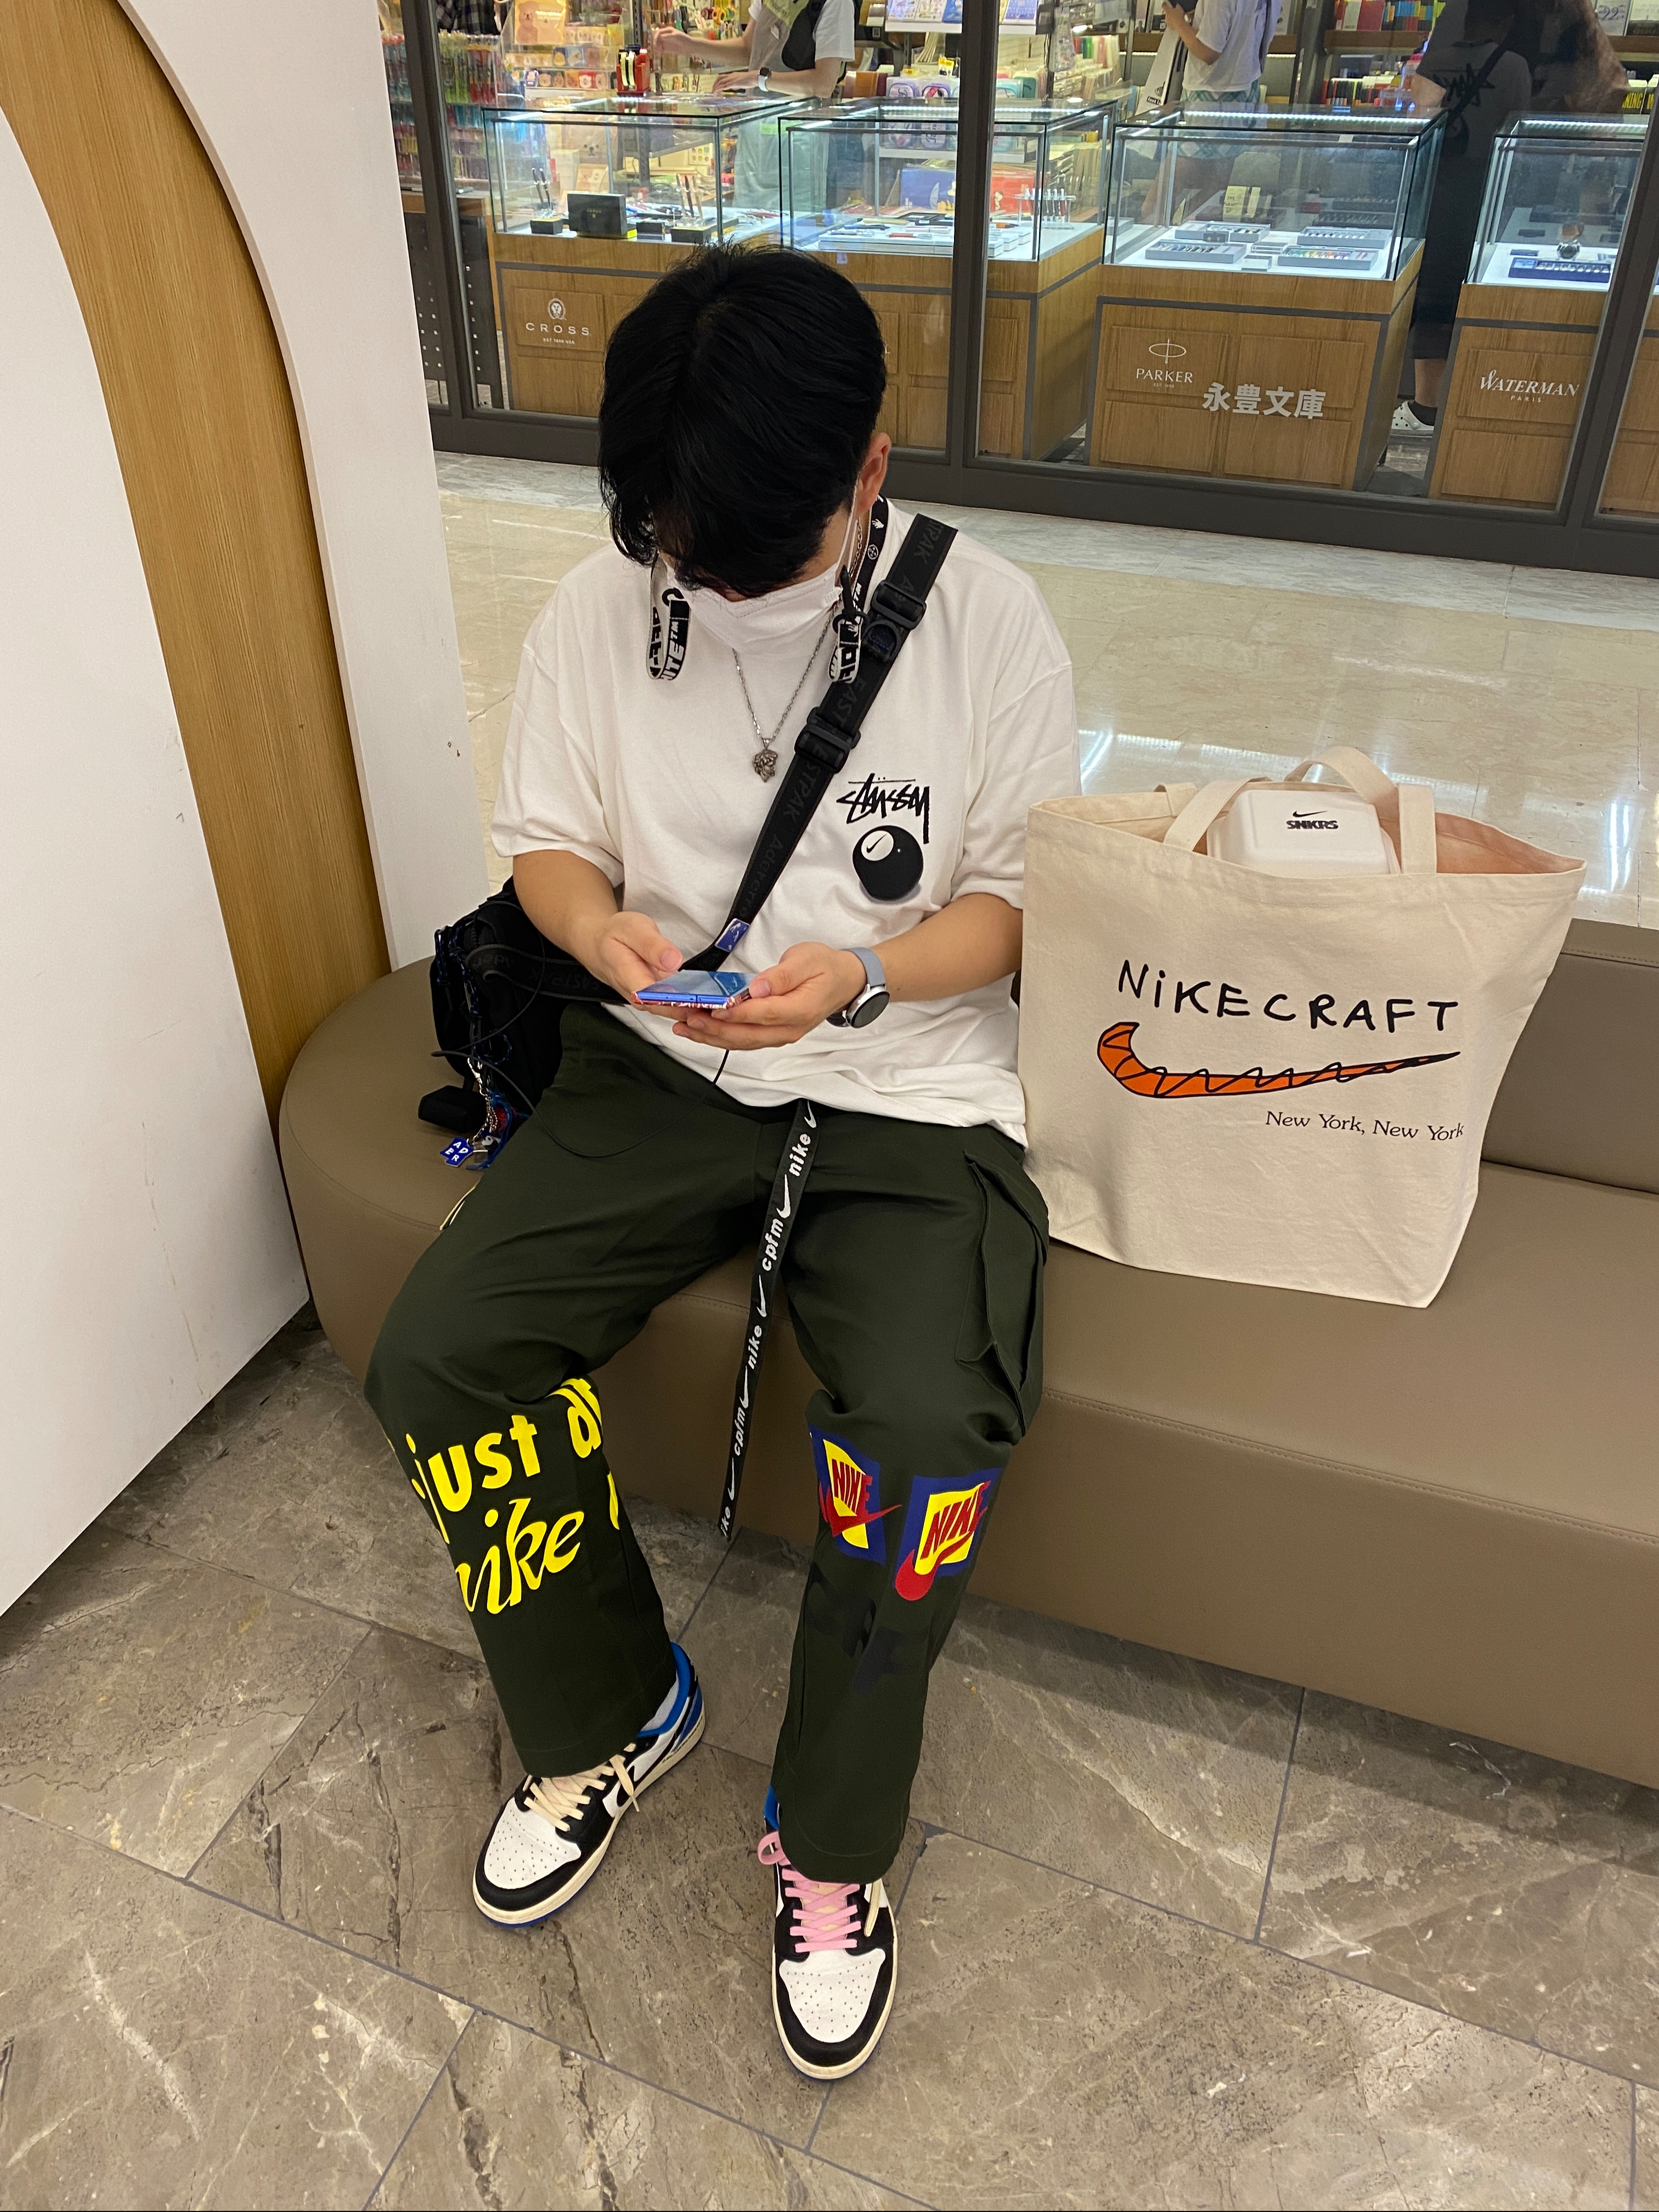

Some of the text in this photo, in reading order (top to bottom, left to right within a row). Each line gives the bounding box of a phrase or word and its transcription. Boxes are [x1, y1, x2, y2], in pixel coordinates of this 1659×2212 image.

[526, 322, 589, 336] CROSS
[1136, 368, 1193, 383] PARKER
[1480, 369, 1579, 397] WATERMAN
[1286, 820, 1339, 830] SNKRS
[1265, 1111, 1464, 1142] New York, New York
[720, 1133, 811, 1537] ike cpfm nike cpfm nike
